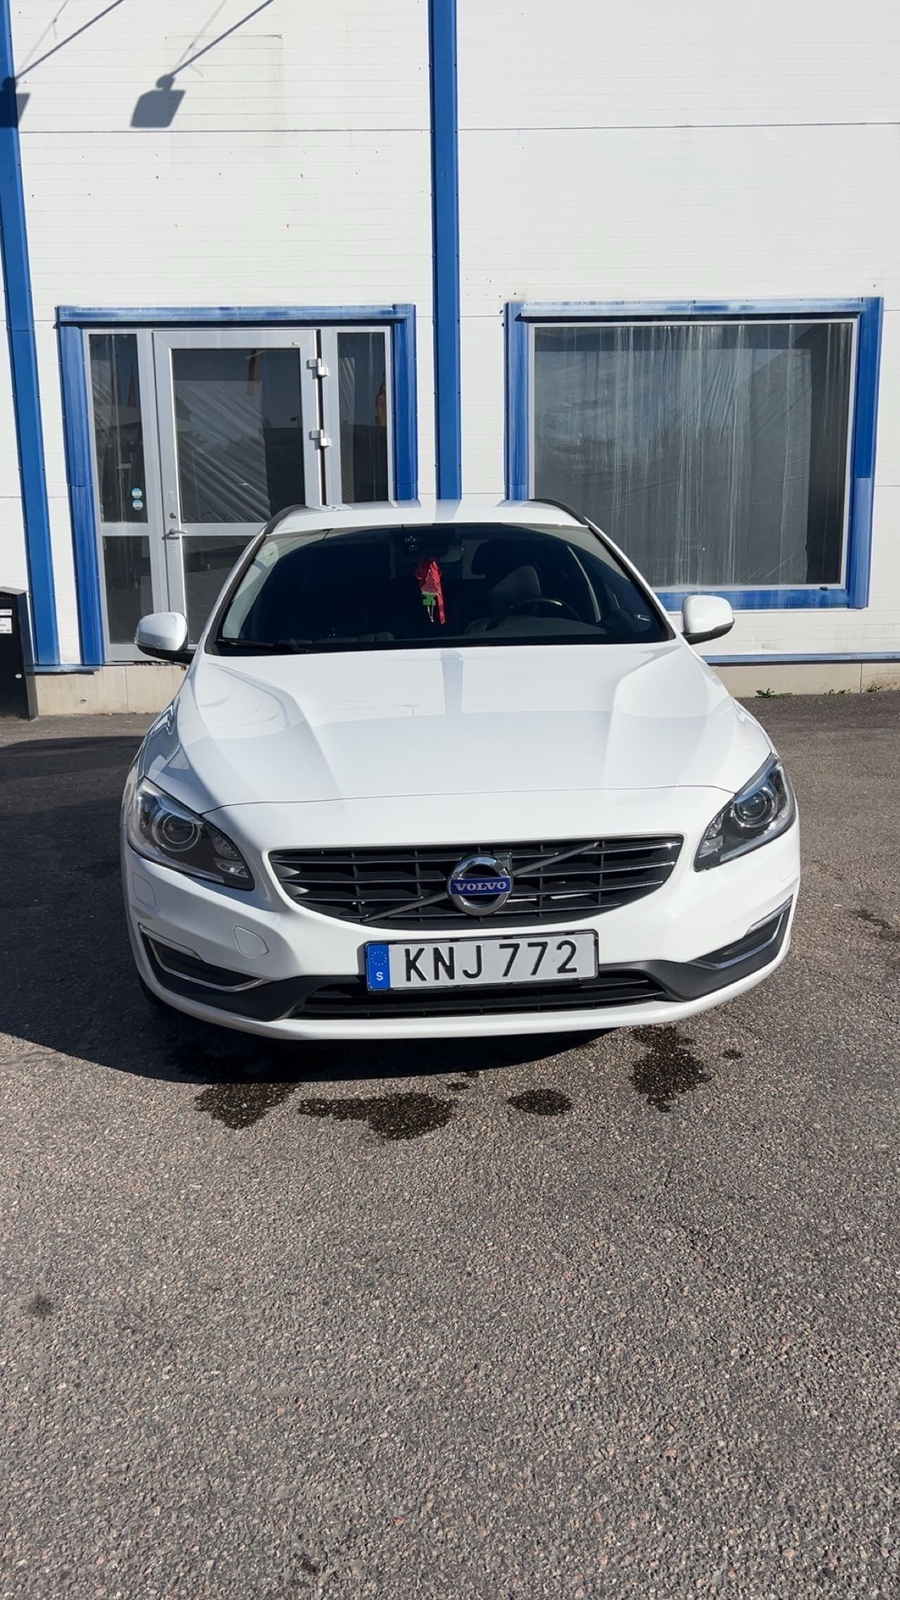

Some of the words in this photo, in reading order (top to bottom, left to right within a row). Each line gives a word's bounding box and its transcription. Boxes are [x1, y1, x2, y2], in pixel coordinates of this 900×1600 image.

[454, 881, 507, 891] VOLVO
[405, 945, 482, 982] KNJ
[500, 940, 577, 977] 772
[376, 971, 384, 981] S
